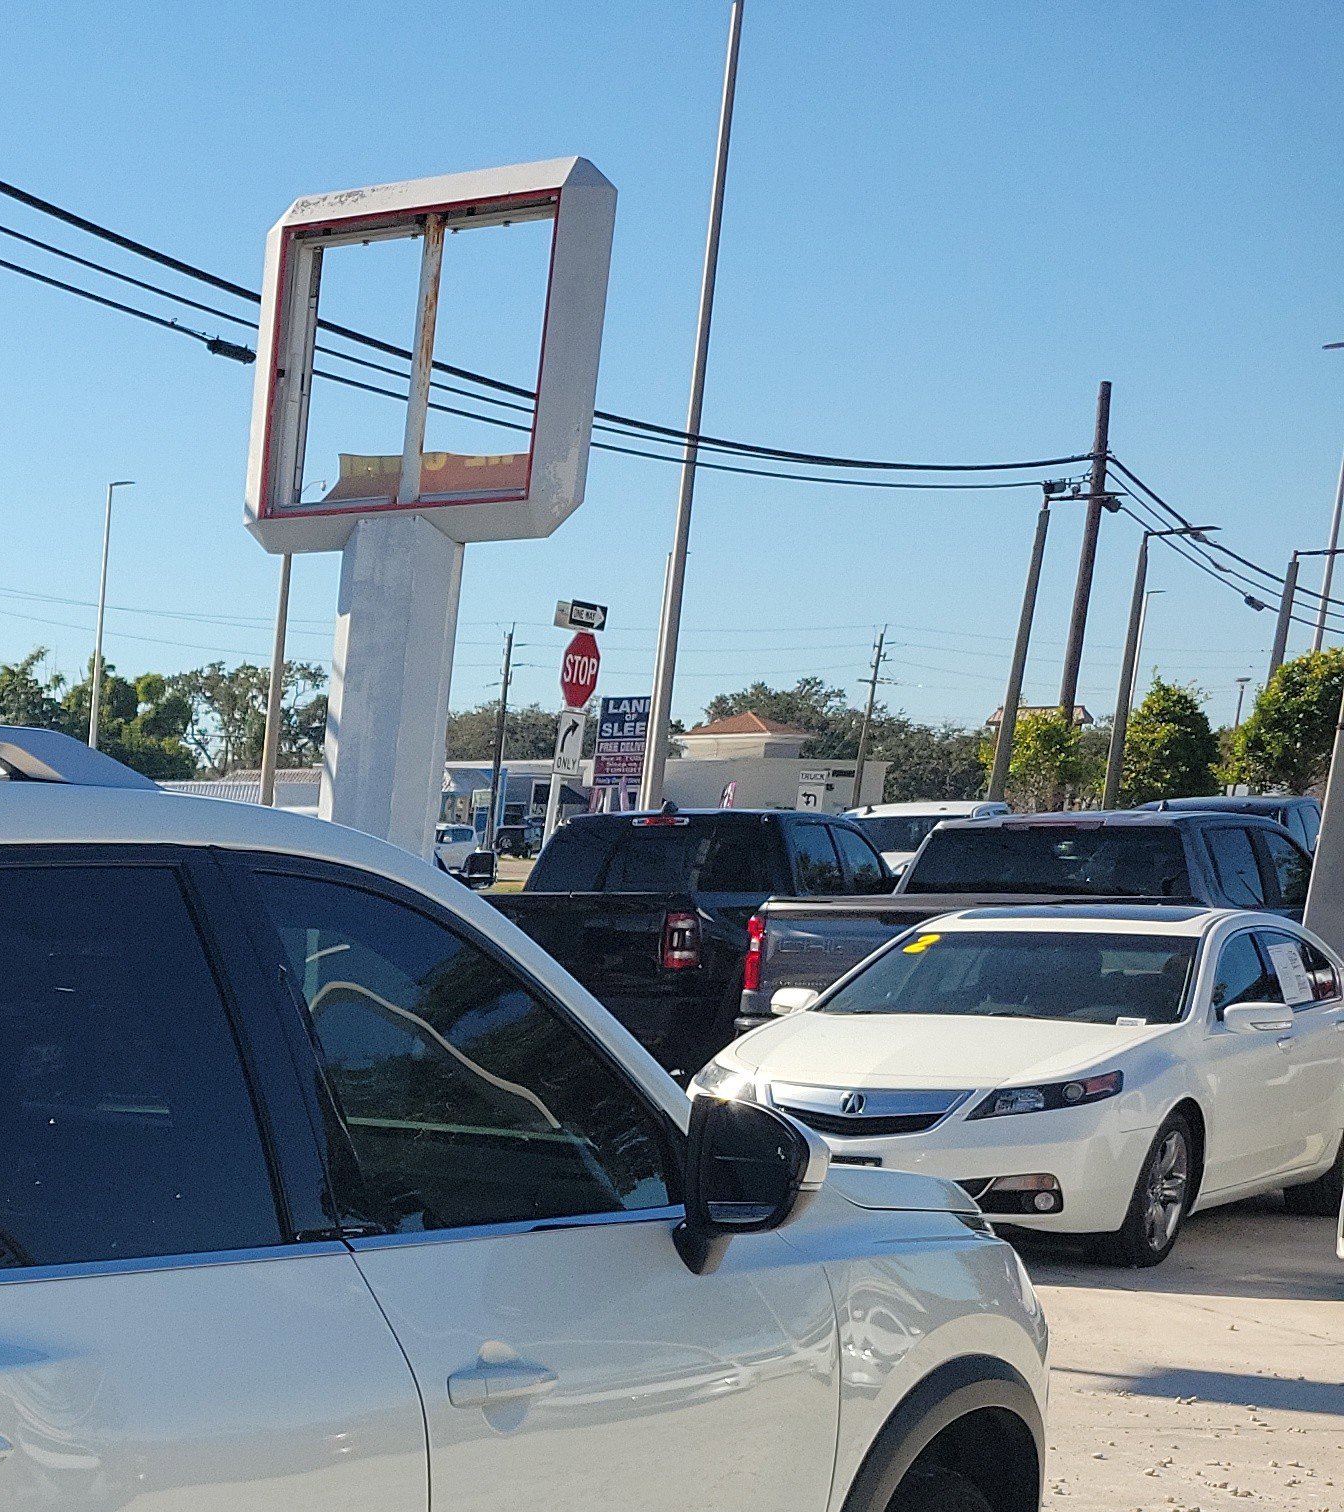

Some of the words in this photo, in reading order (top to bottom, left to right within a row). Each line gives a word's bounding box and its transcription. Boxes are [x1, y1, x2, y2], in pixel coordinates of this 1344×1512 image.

[573, 608, 584, 620] ONE
[563, 653, 598, 686] STOP
[624, 713, 637, 721] OF
[601, 722, 646, 737] SLEE
[599, 742, 619, 752] FREE
[556, 756, 577, 770] ONLY
[801, 772, 825, 781] TRUCK
